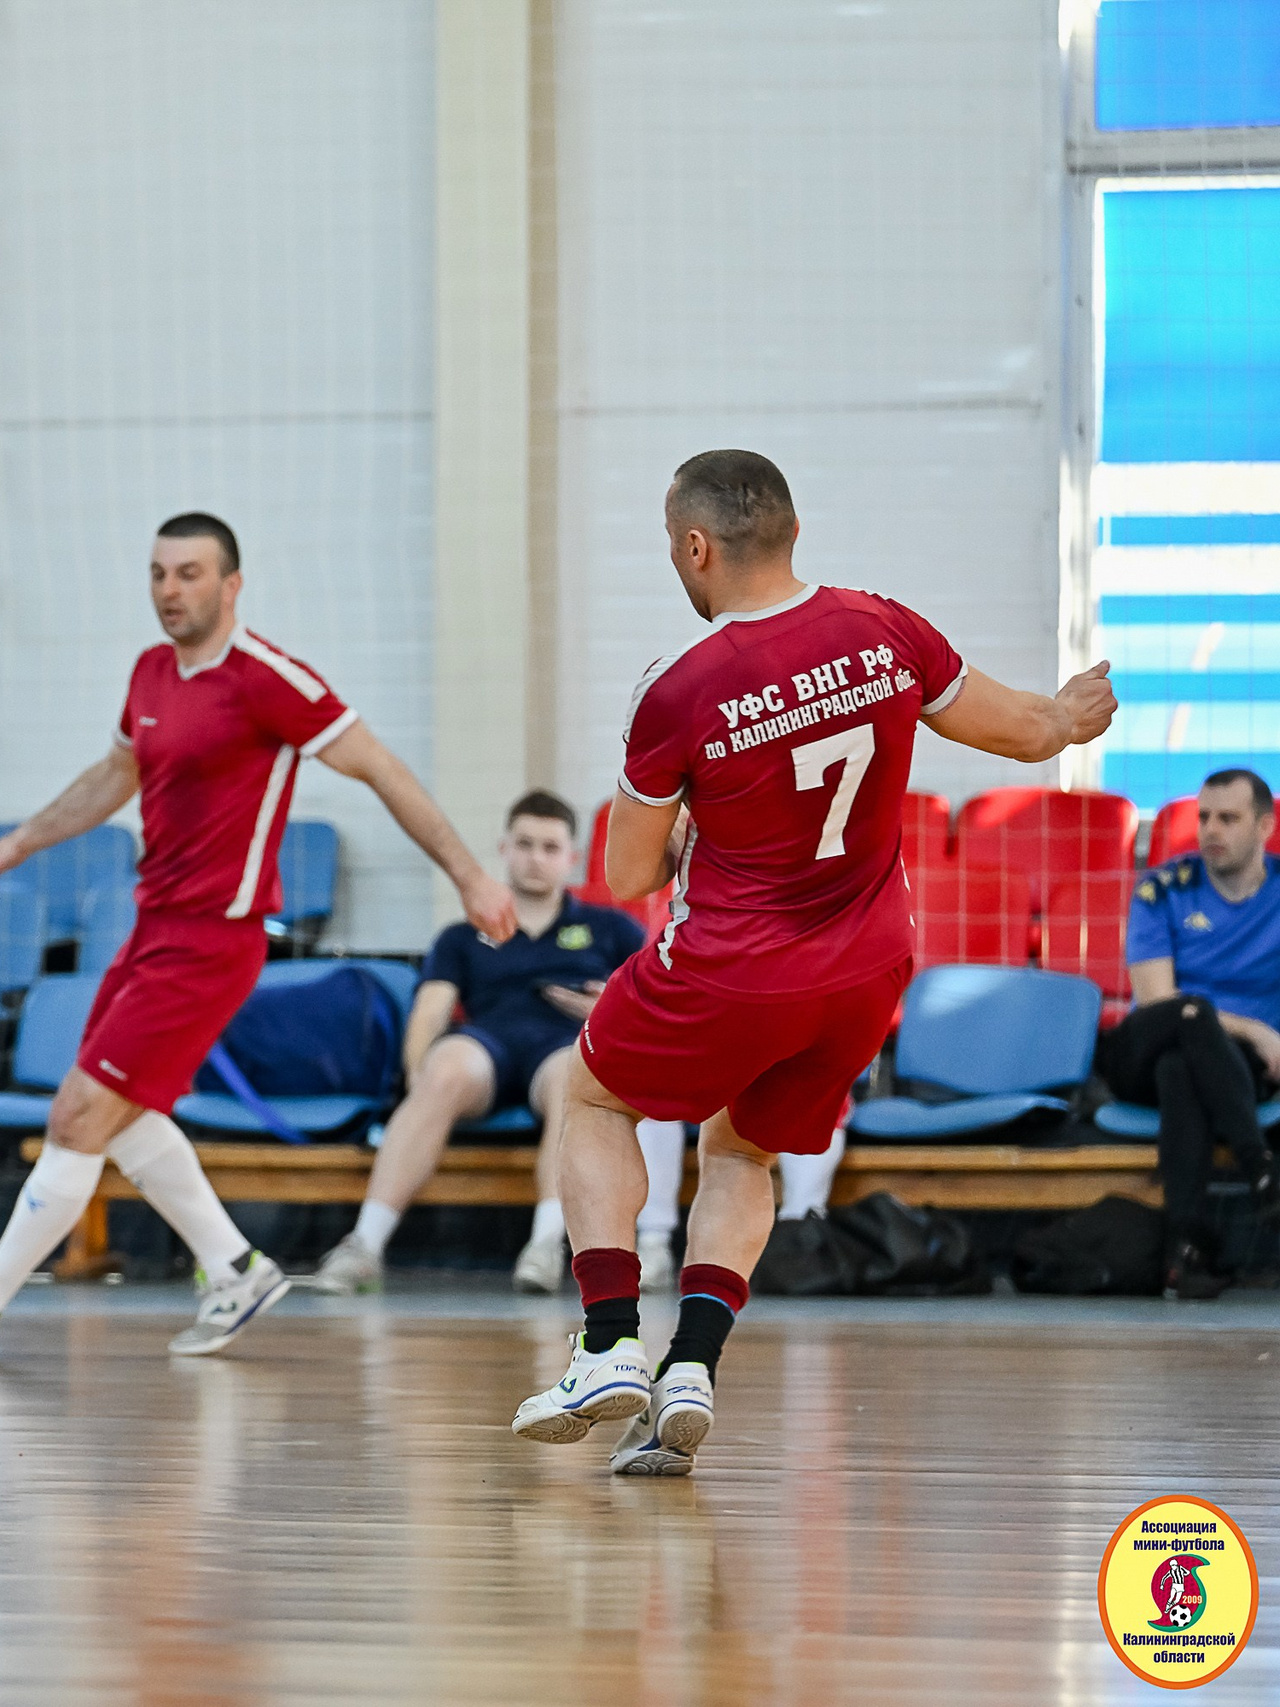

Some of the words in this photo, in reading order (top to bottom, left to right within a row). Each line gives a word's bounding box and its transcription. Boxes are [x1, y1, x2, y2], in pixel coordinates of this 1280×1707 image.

[718, 684, 785, 729] УФС
[790, 656, 852, 701] ВНГ
[858, 644, 894, 677] РФ
[729, 672, 894, 753] КАЛИНИНГРАДСКОЙ
[791, 723, 876, 860] 7
